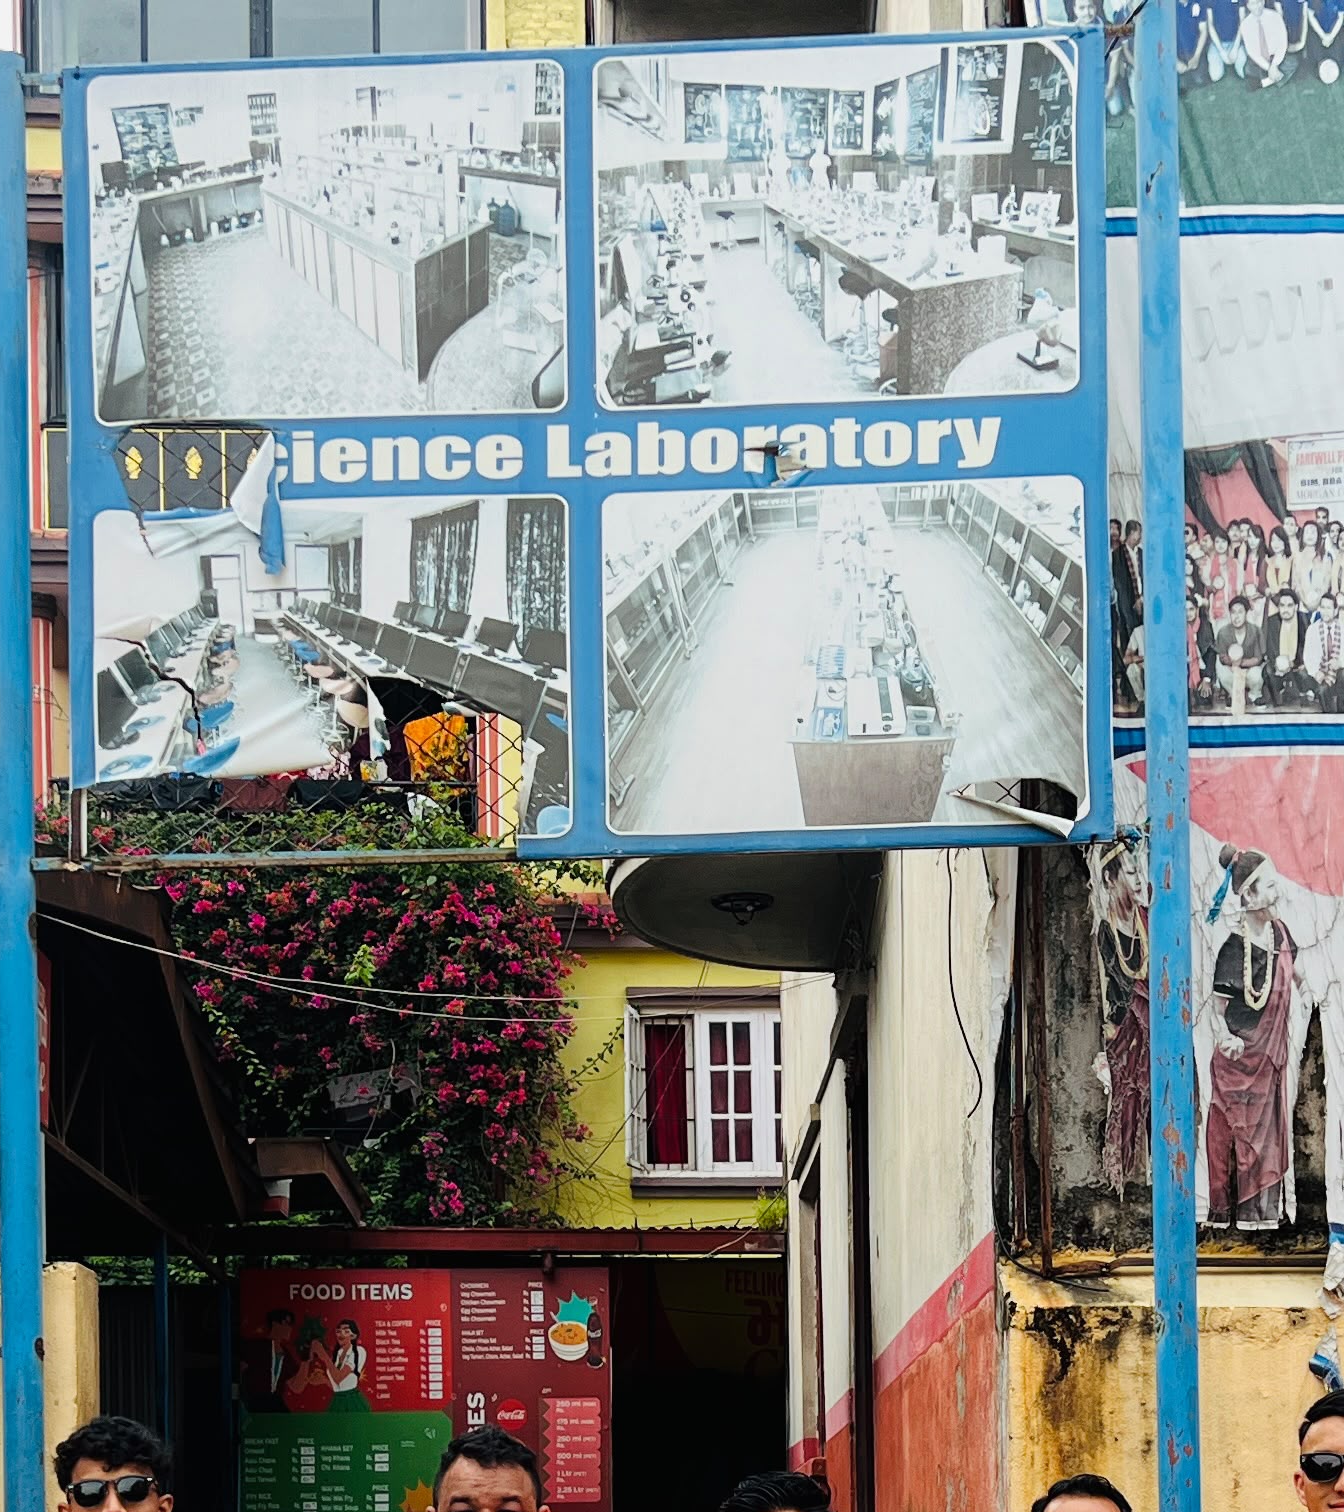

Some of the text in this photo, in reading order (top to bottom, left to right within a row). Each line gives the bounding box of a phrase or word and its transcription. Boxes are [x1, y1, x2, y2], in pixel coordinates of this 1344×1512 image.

[272, 416, 1002, 484] cience Laboratory
[289, 1283, 414, 1301] FOOD ITEMS
